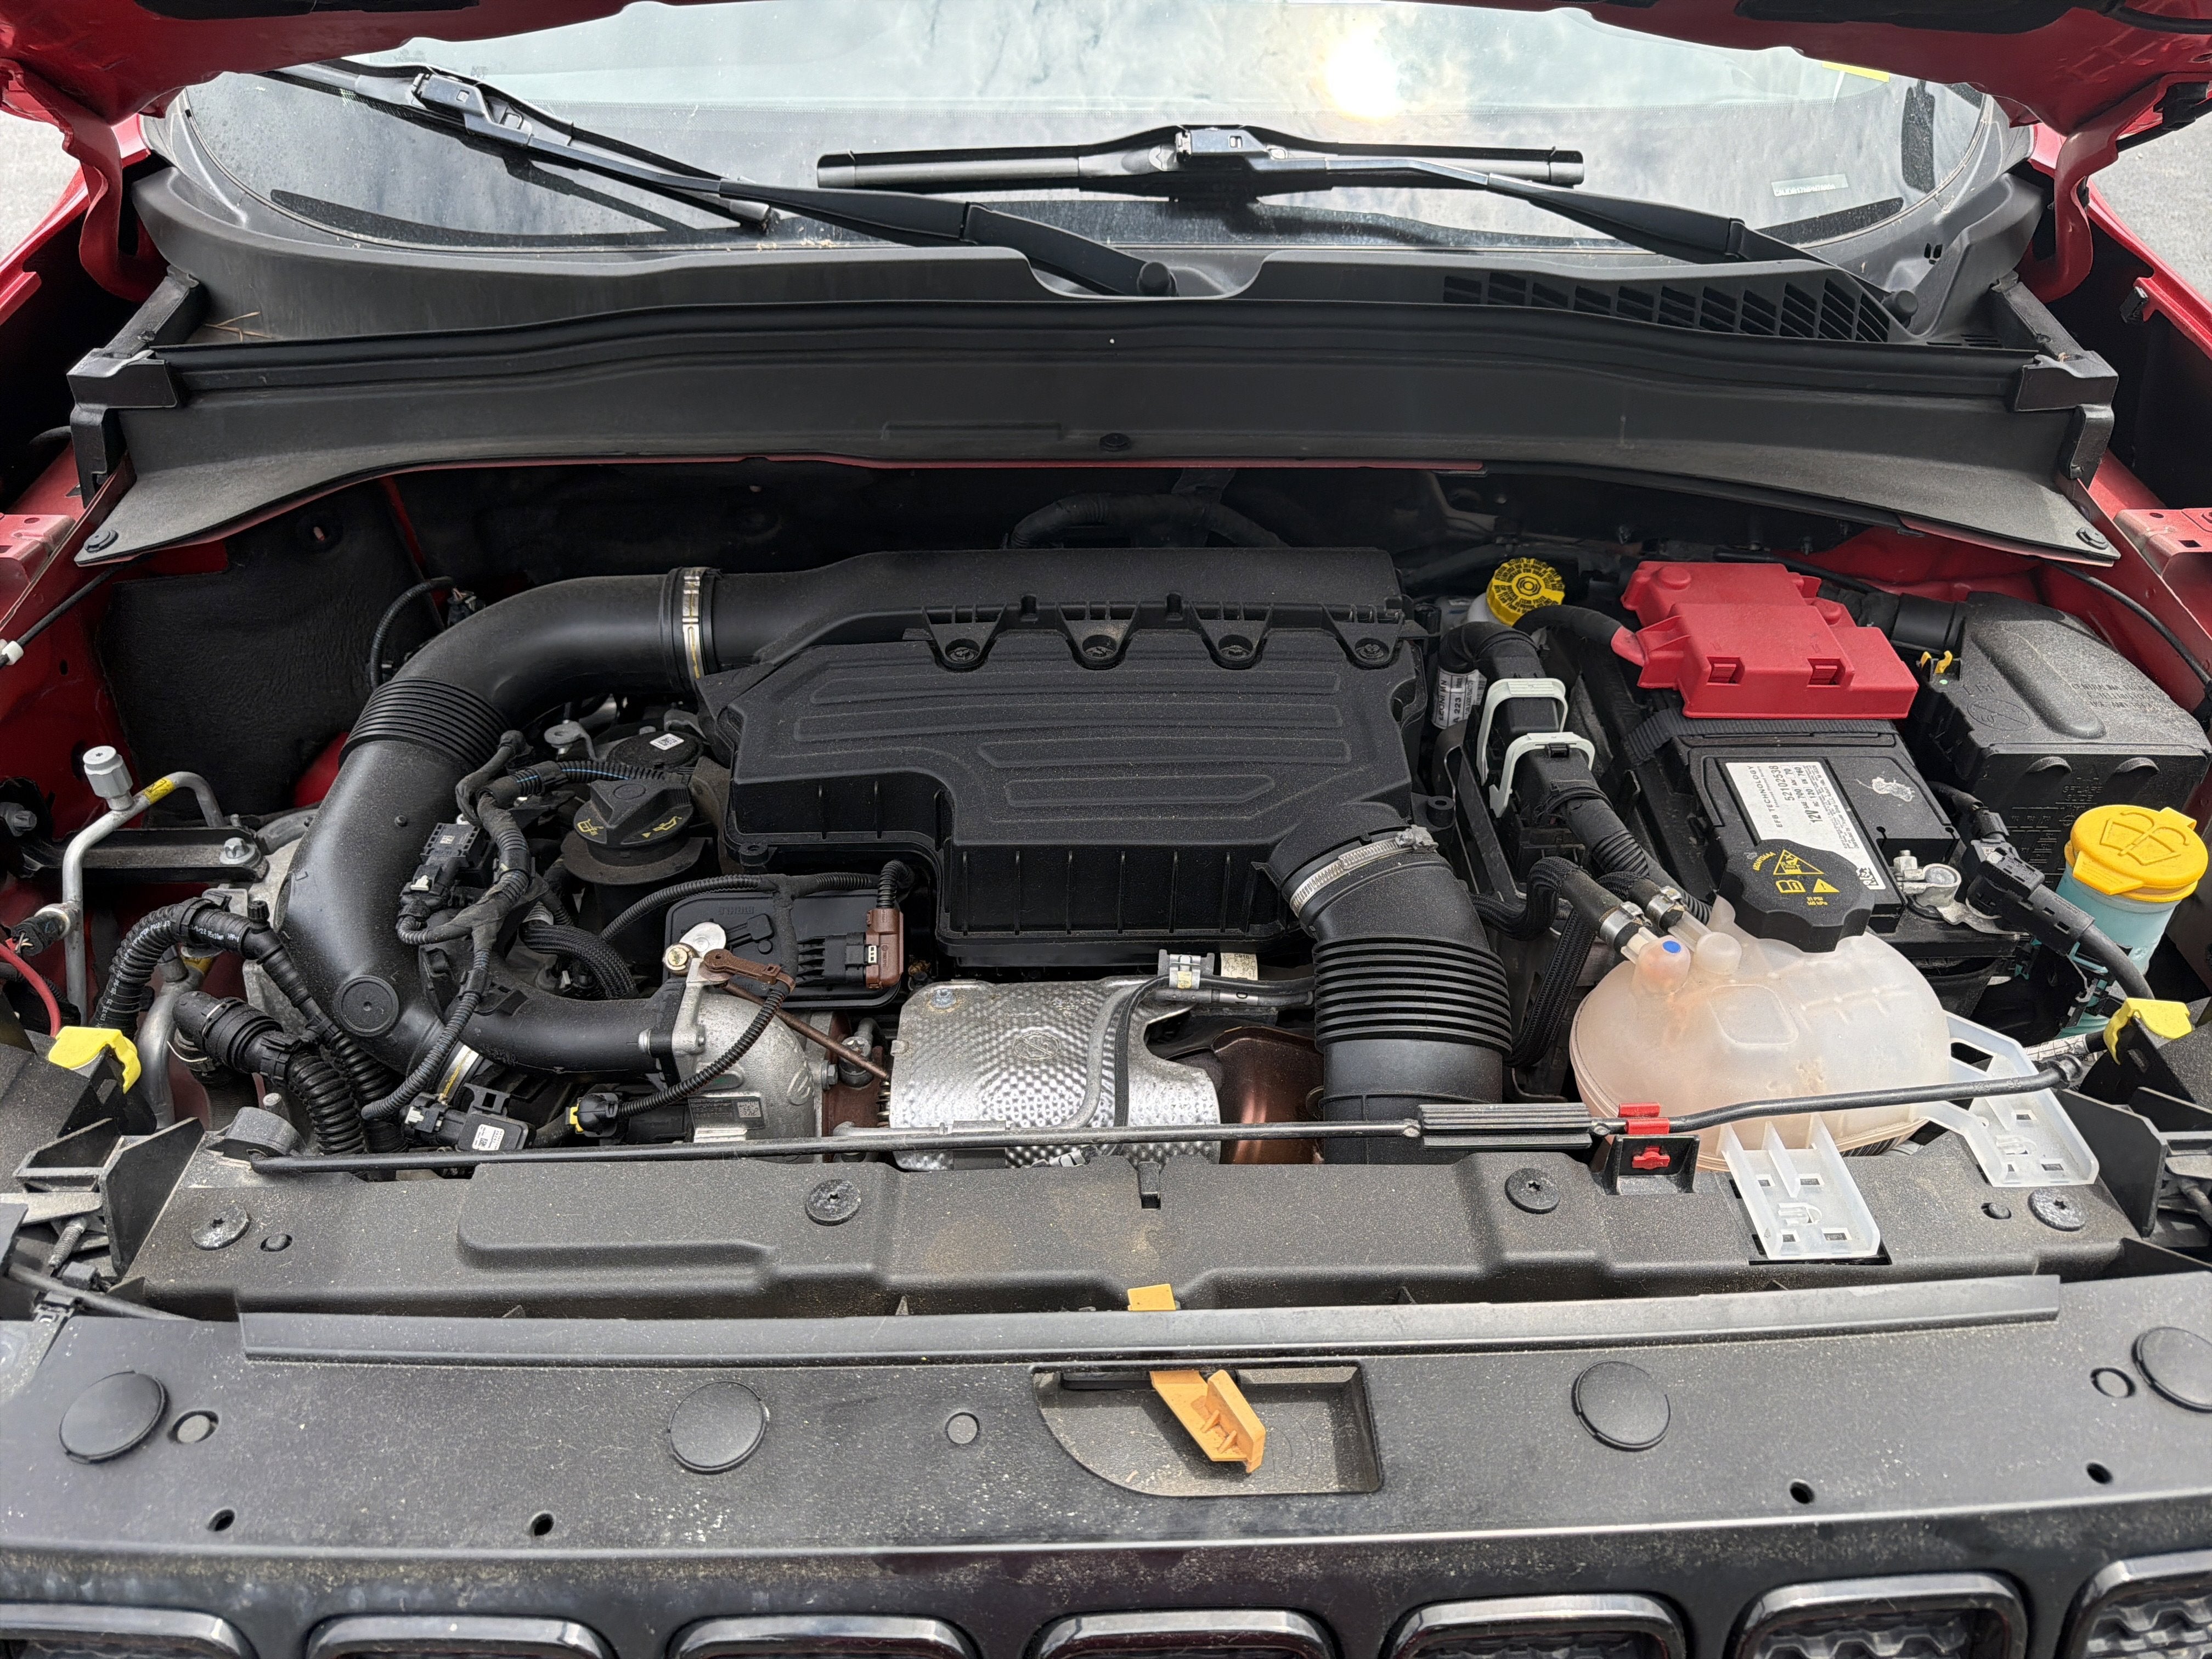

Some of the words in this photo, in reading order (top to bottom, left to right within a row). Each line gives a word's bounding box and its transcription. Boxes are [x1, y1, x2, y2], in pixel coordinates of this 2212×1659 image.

[1794, 766, 1805, 777] 760
[1747, 765, 1775, 812] TECHNOLOGY
[1768, 765, 1795, 801] 52102538
[1795, 788, 1805, 799] 700
[1805, 788, 1816, 799] 120
[1772, 814, 1783, 828] EFB
[1804, 810, 1824, 823] 12V
